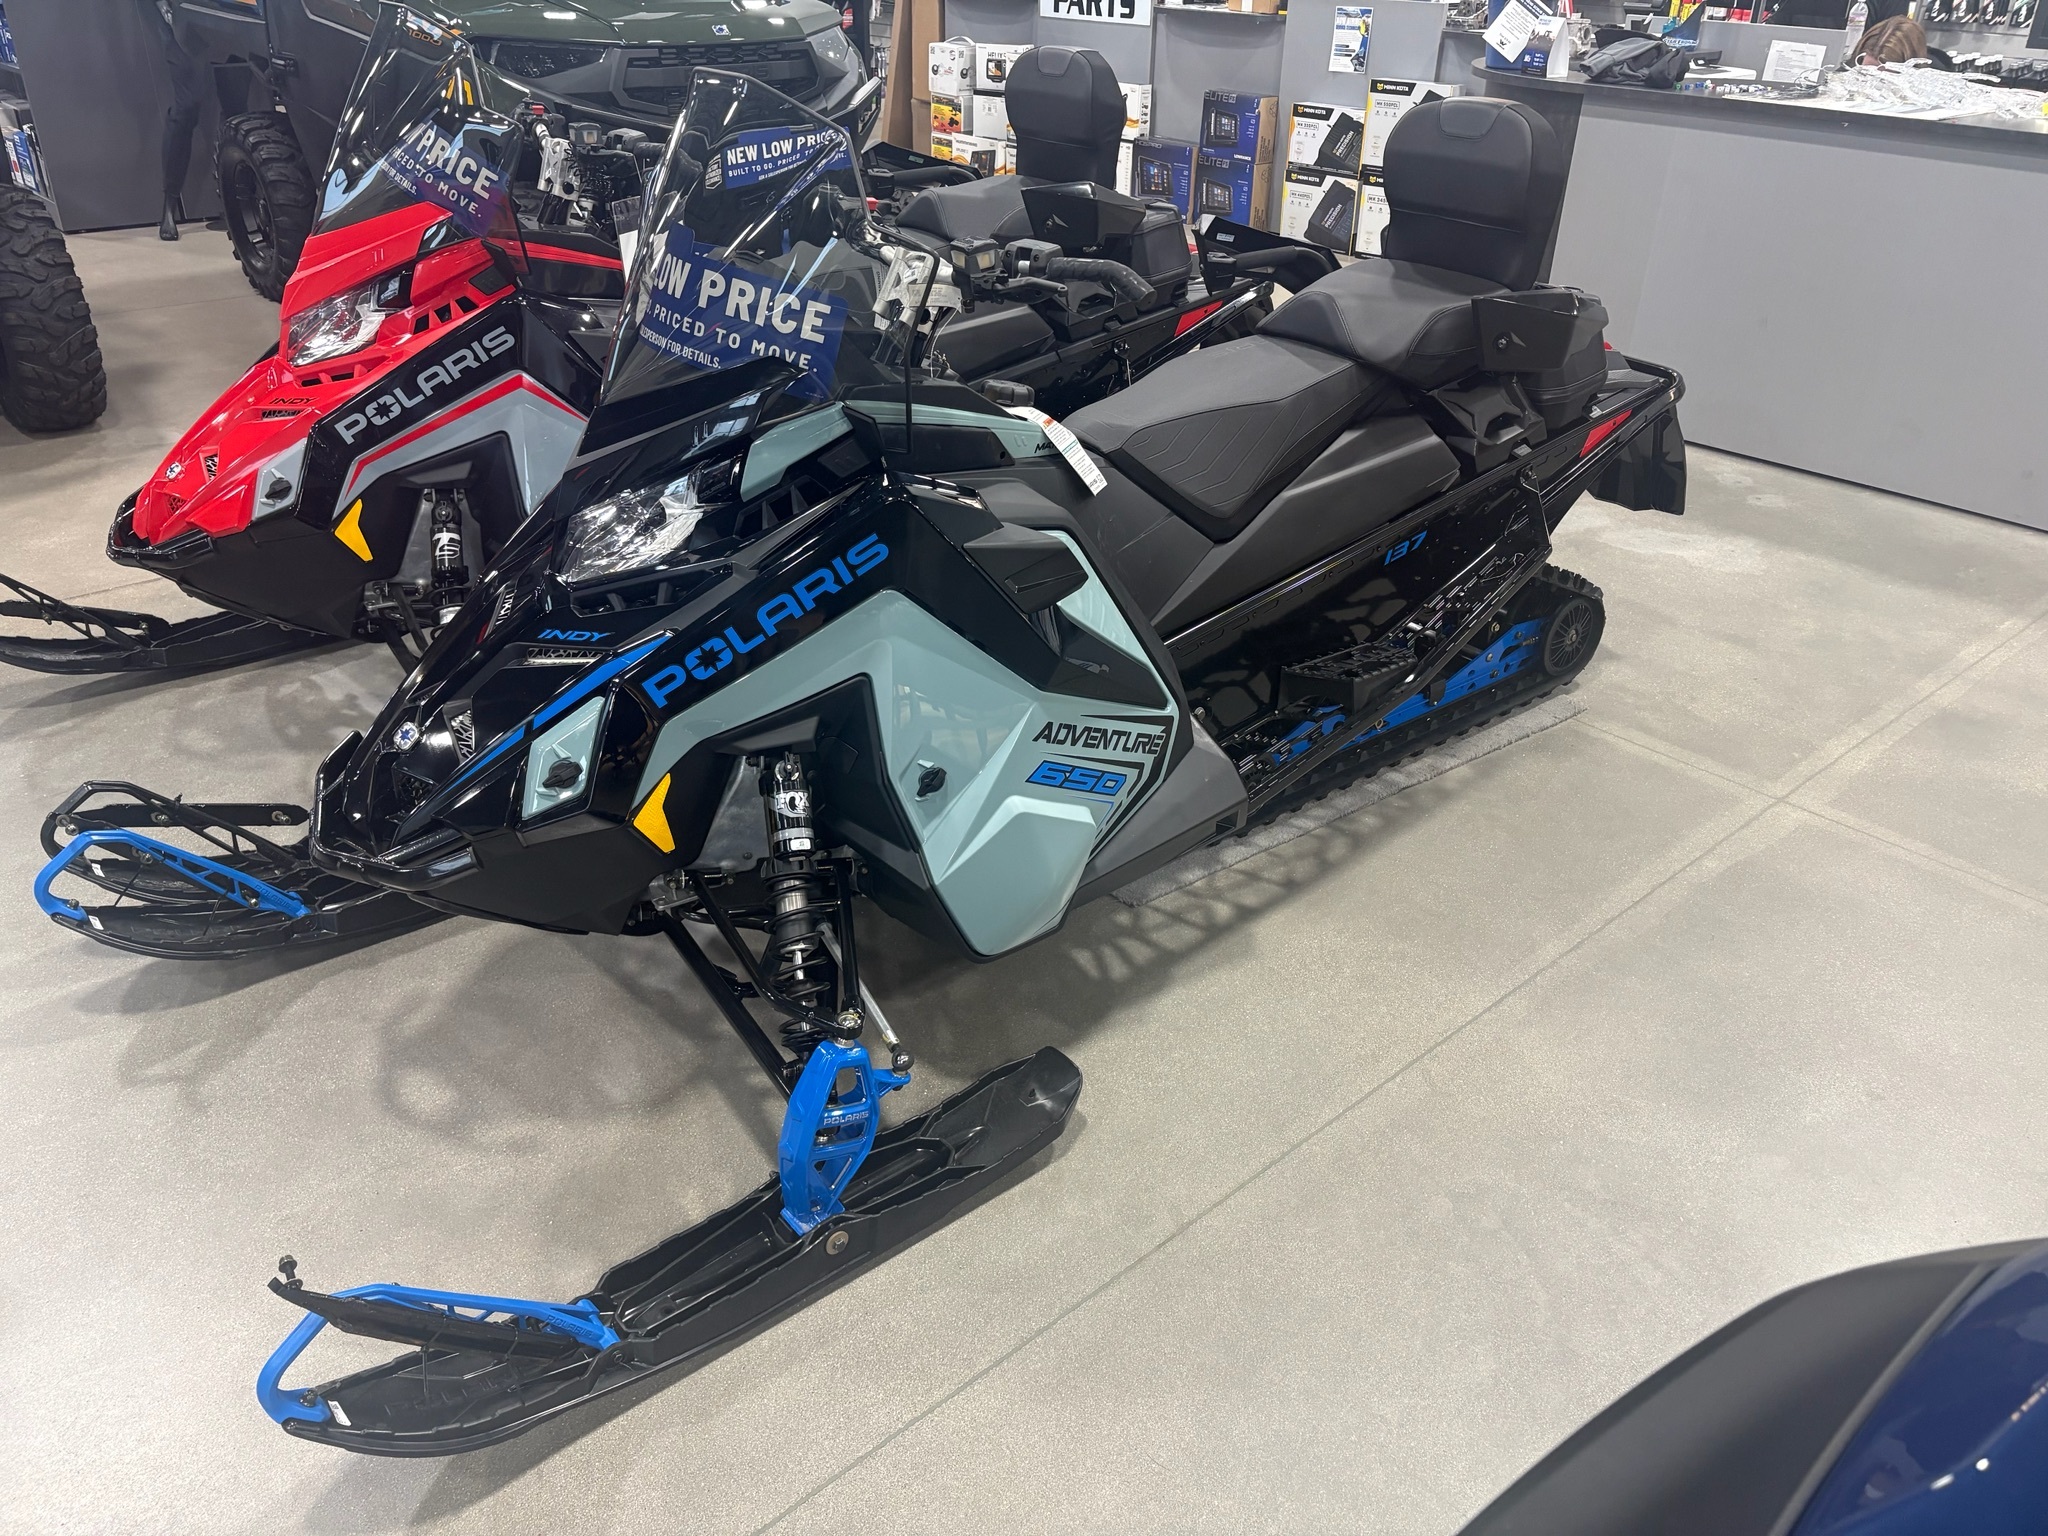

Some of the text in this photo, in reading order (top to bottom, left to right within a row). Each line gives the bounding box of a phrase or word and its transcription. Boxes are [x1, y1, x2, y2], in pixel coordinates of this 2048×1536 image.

[1204, 90, 1229, 102] ELITE
[416, 128, 499, 200] PRICE
[727, 144, 758, 167] NEW
[762, 138, 794, 159] LOW
[797, 130, 834, 151] PRIC
[1199, 155, 1222, 167] ELITE
[728, 167, 750, 178] BUILT
[752, 165, 762, 174] TO
[764, 162, 775, 170] GO.
[777, 153, 800, 167] PRICED
[394, 173, 417, 195] DETAILS.
[418, 168, 434, 184] TO
[437, 181, 482, 217] MOVE.
[698, 269, 832, 344] PRICE
[653, 304, 818, 372] PRICED TO MOVE.
[666, 339, 682, 356] FOR
[682, 346, 721, 369] DETAILS.
[269, 397, 318, 405] INDY
[334, 325, 516, 446] POLARIS
[1383, 530, 1428, 566] 137
[538, 628, 615, 643] INDY
[641, 532, 890, 709] POLARIS
[1032, 721, 1166, 755] ADVENTURE
[1025, 760, 1128, 797] 650
[776, 791, 810, 815] FOX
[823, 1111, 869, 1126] POLARIS
[548, 1314, 593, 1338] POLARIS
